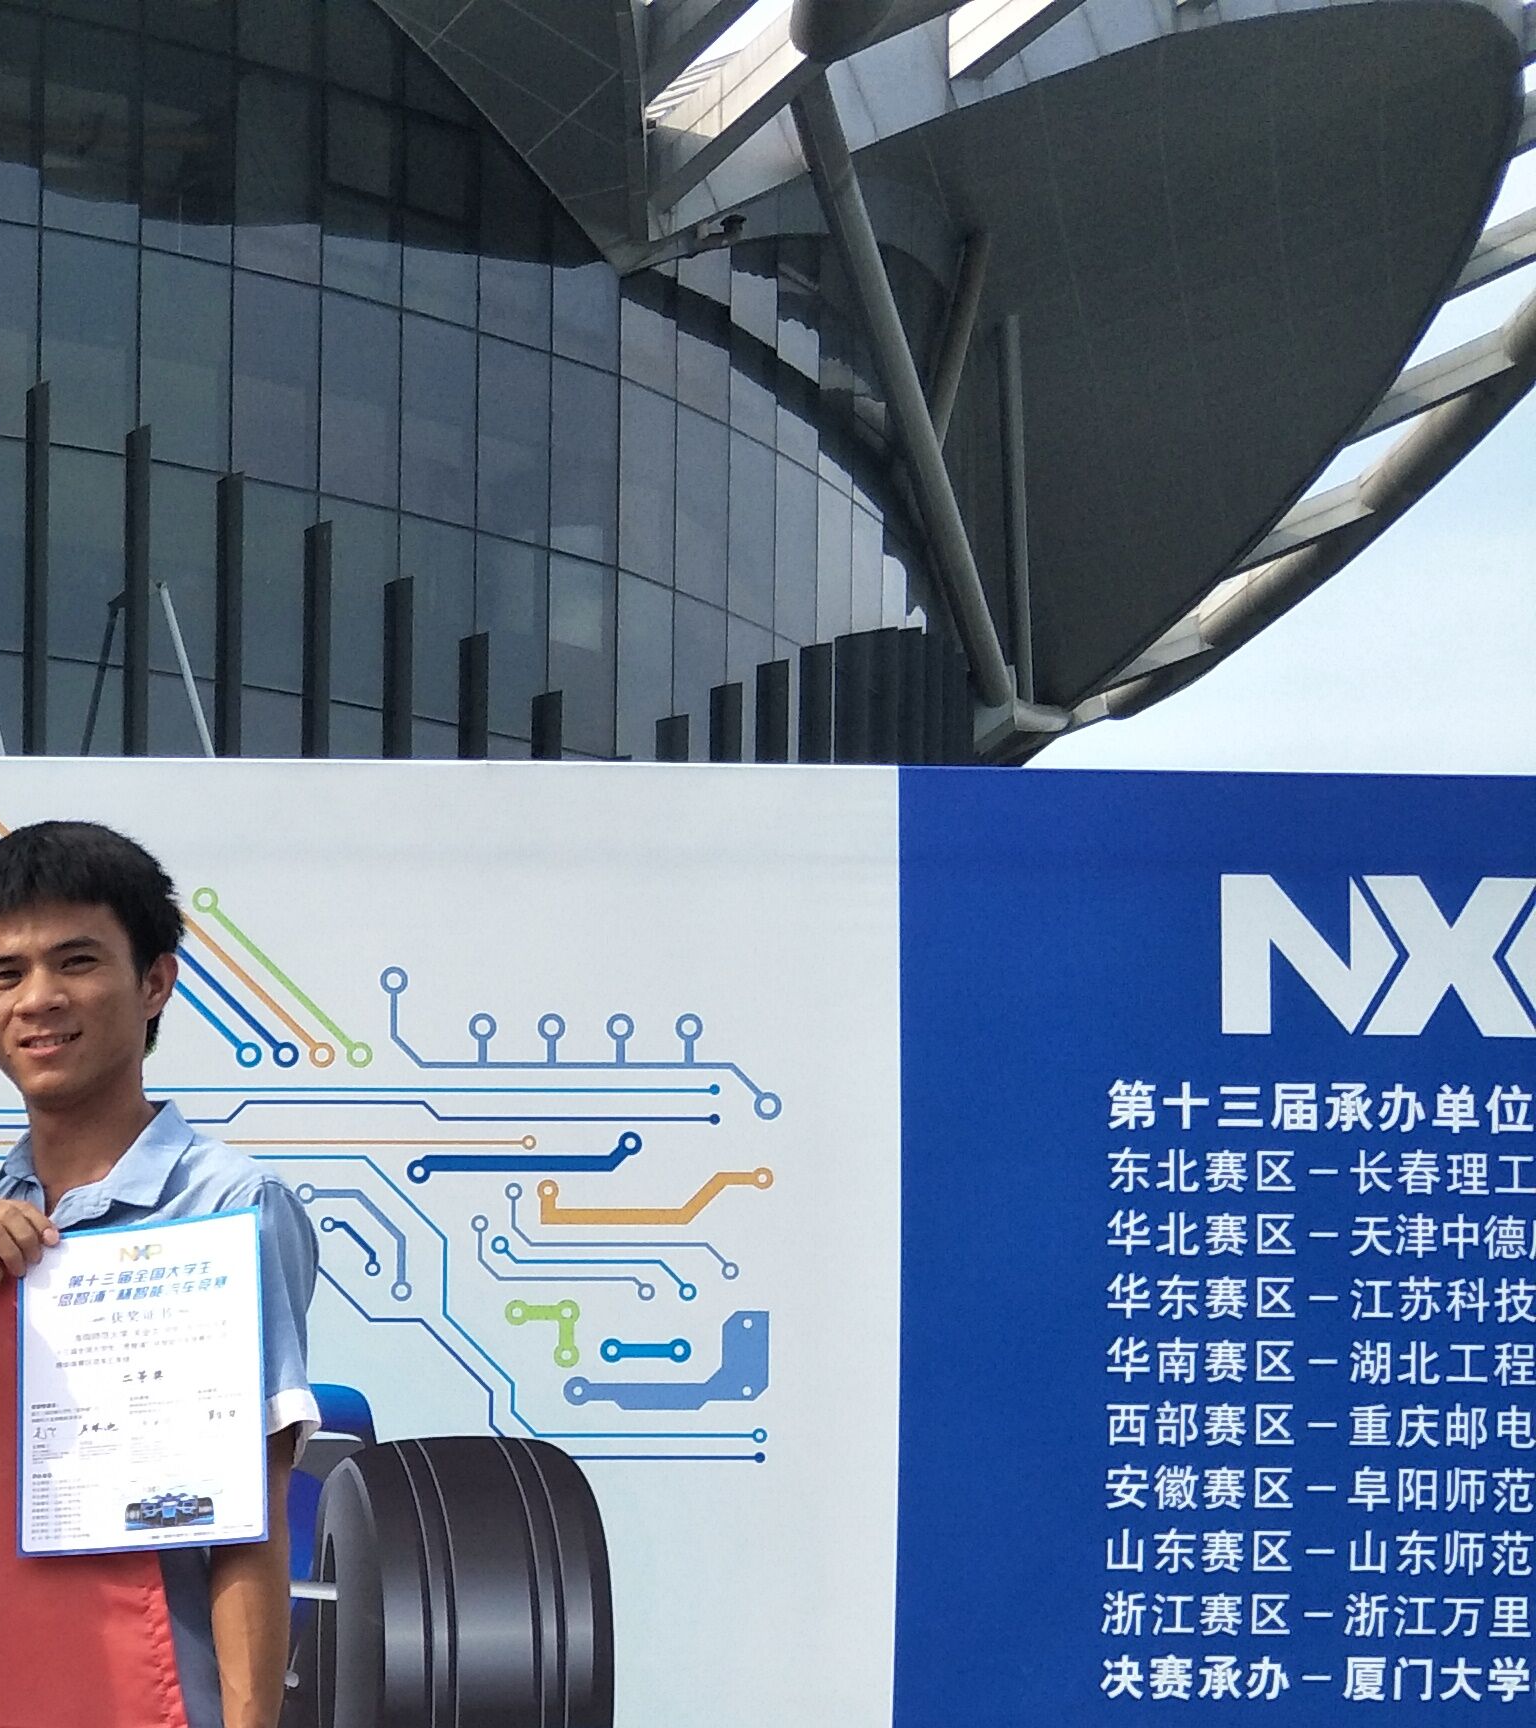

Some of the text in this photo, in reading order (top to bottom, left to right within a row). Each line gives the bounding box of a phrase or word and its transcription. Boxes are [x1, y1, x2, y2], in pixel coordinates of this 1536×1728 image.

[1221, 873, 1536, 1038] NX
[1106, 1078, 1533, 1134] 第十三届承办单位
[1106, 1210, 1536, 1260] 华北赛区-天津中德
